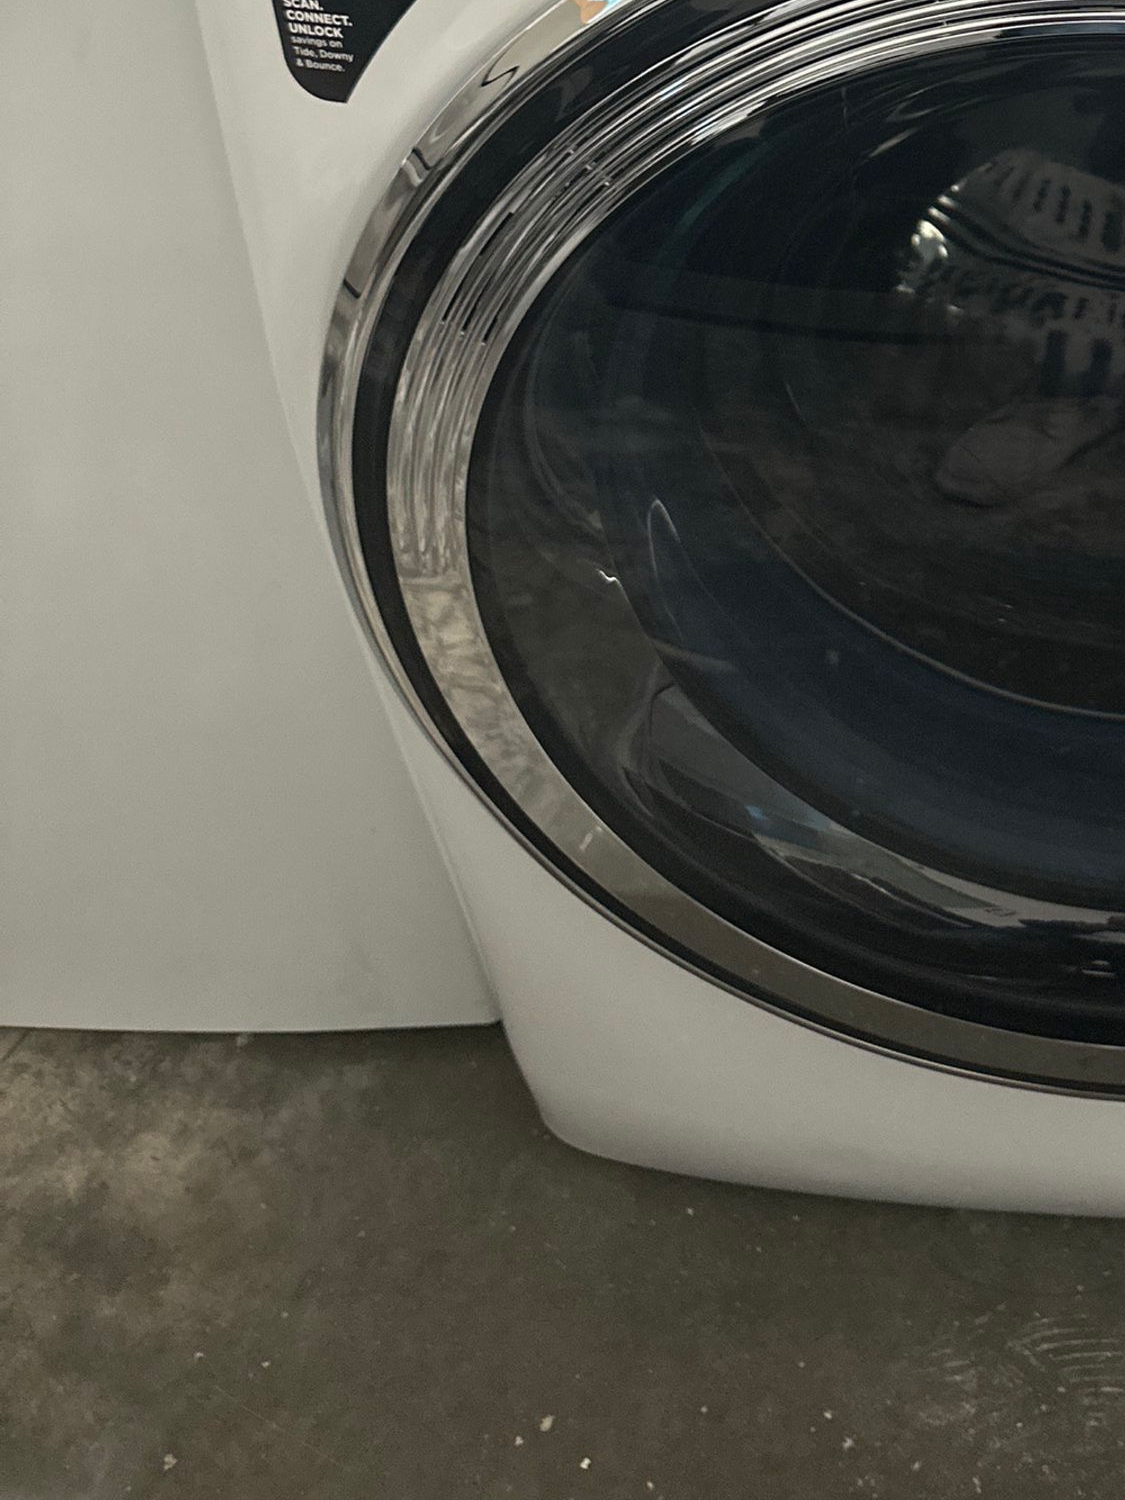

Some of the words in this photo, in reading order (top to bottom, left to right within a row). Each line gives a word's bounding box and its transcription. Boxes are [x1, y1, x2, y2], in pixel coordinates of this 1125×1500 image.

[286, 10, 353, 26] CONNECT.
[288, 23, 344, 38] UNLOCK
[291, 36, 328, 48] savings
[330, 40, 343, 48] on
[319, 49, 354, 62] Downy
[296, 59, 304, 67] &
[306, 60, 345, 72] Bounce.
